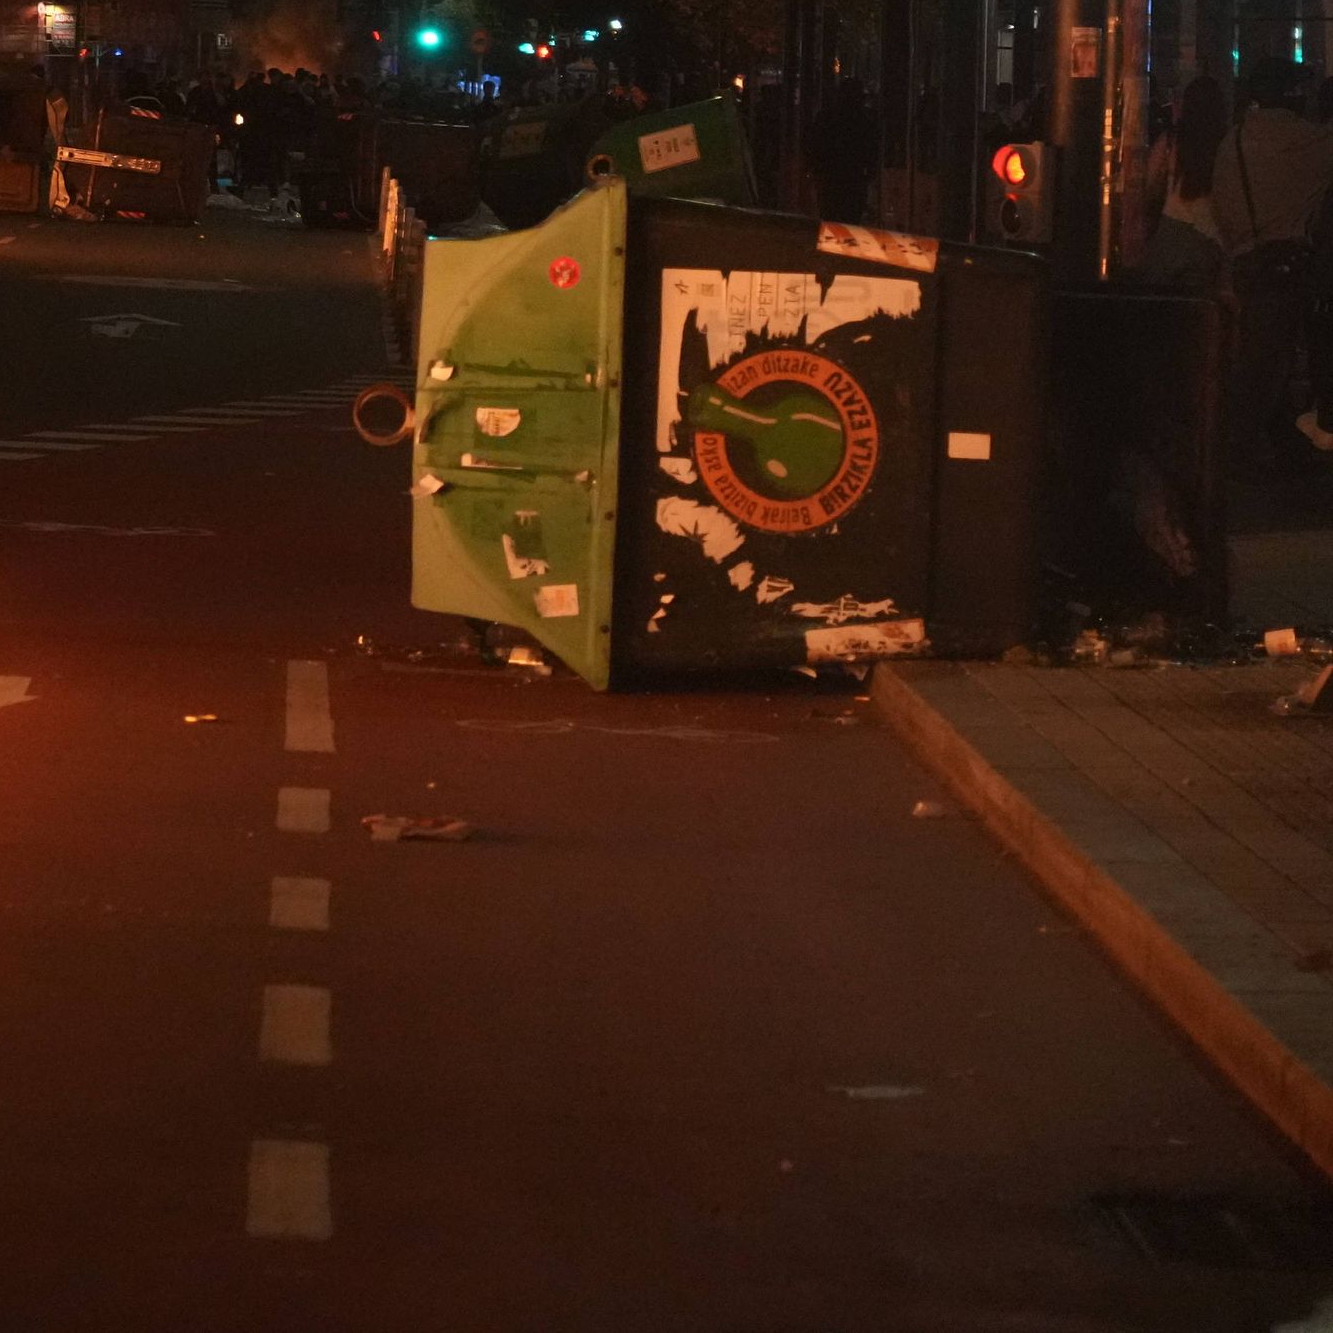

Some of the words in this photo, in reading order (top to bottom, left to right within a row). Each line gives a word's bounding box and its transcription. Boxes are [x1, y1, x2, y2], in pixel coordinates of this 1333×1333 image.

[726, 365, 759, 394] izan
[762, 355, 820, 379] ditzake
[822, 371, 872, 431] EZAZU
[699, 437, 723, 473] asko
[714, 473, 758, 516] bizitza
[818, 437, 873, 516] BIRZIKLA
[760, 506, 812, 526] Beirak
